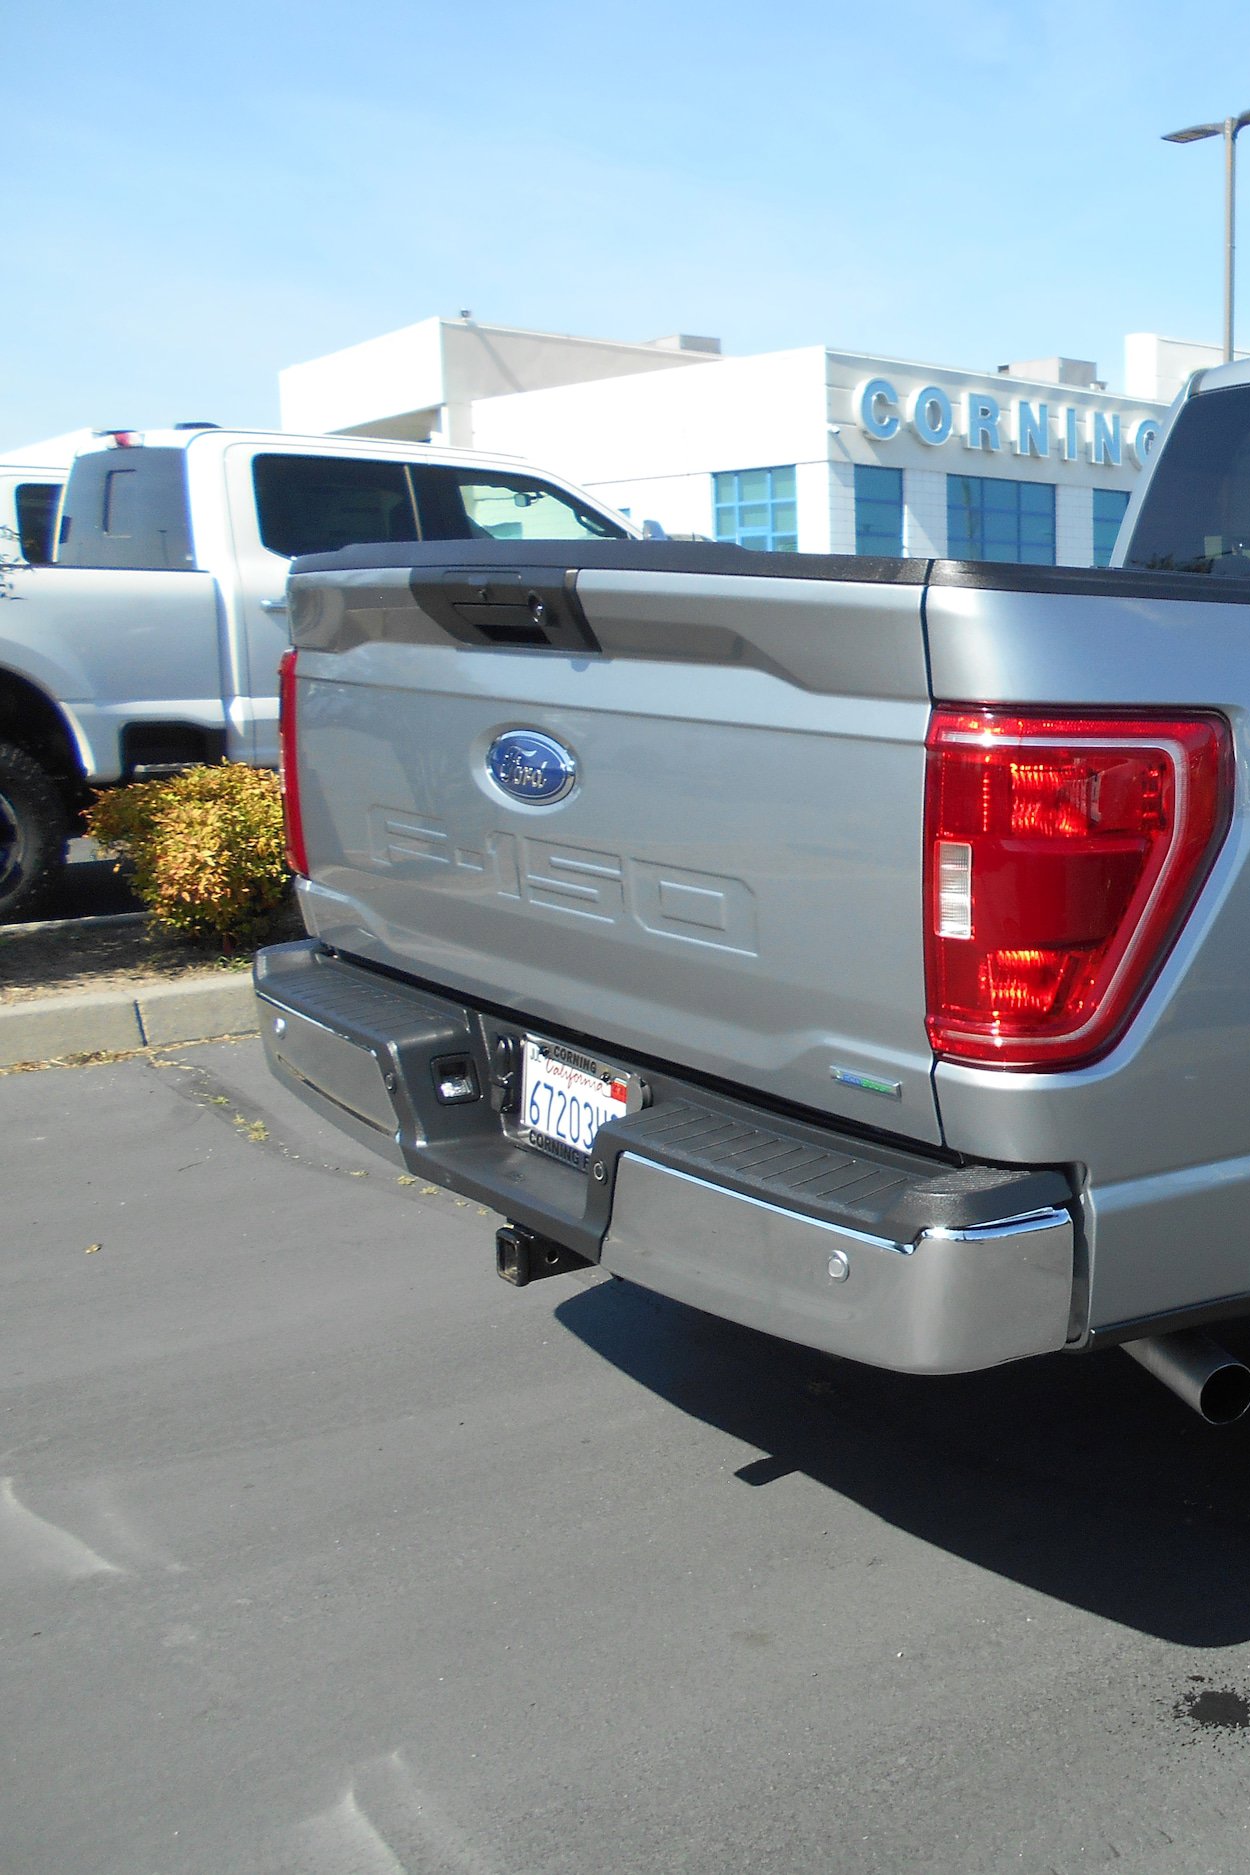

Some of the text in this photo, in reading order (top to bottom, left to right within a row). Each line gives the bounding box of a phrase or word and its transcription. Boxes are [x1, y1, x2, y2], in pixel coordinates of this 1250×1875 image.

[369, 804, 758, 957] F-150
[545, 1058, 608, 1096] California
[553, 1045, 598, 1074] CORNING
[529, 1080, 619, 1150] 67203
[528, 1130, 580, 1163] CORNING
